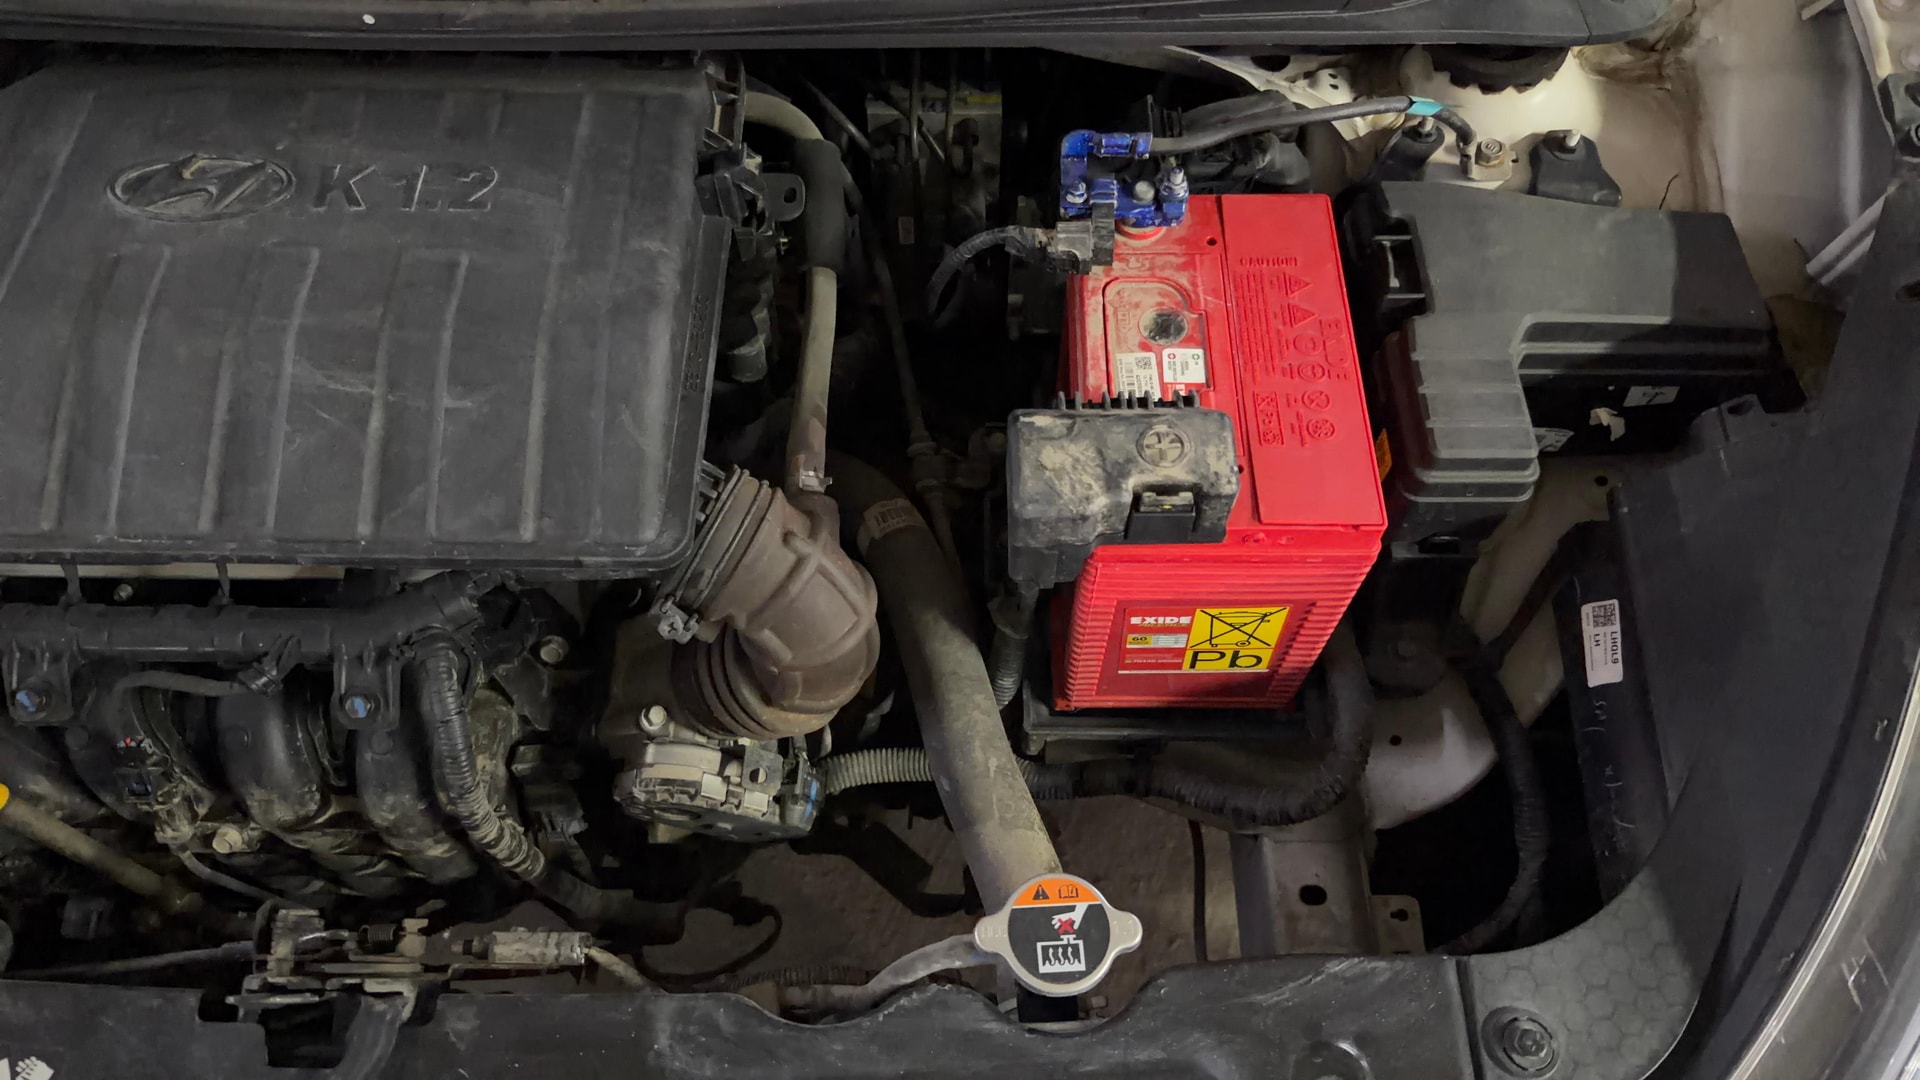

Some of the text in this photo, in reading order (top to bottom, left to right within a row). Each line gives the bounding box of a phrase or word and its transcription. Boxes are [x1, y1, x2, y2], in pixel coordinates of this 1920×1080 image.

[313, 163, 499, 212] K 1.2
[1239, 256, 1298, 267] CAUTION
[1130, 615, 1192, 625] EXIDE
[1594, 633, 1601, 647] LH
[1610, 630, 1619, 665] LHQL9
[1189, 650, 1263, 669] Pb
